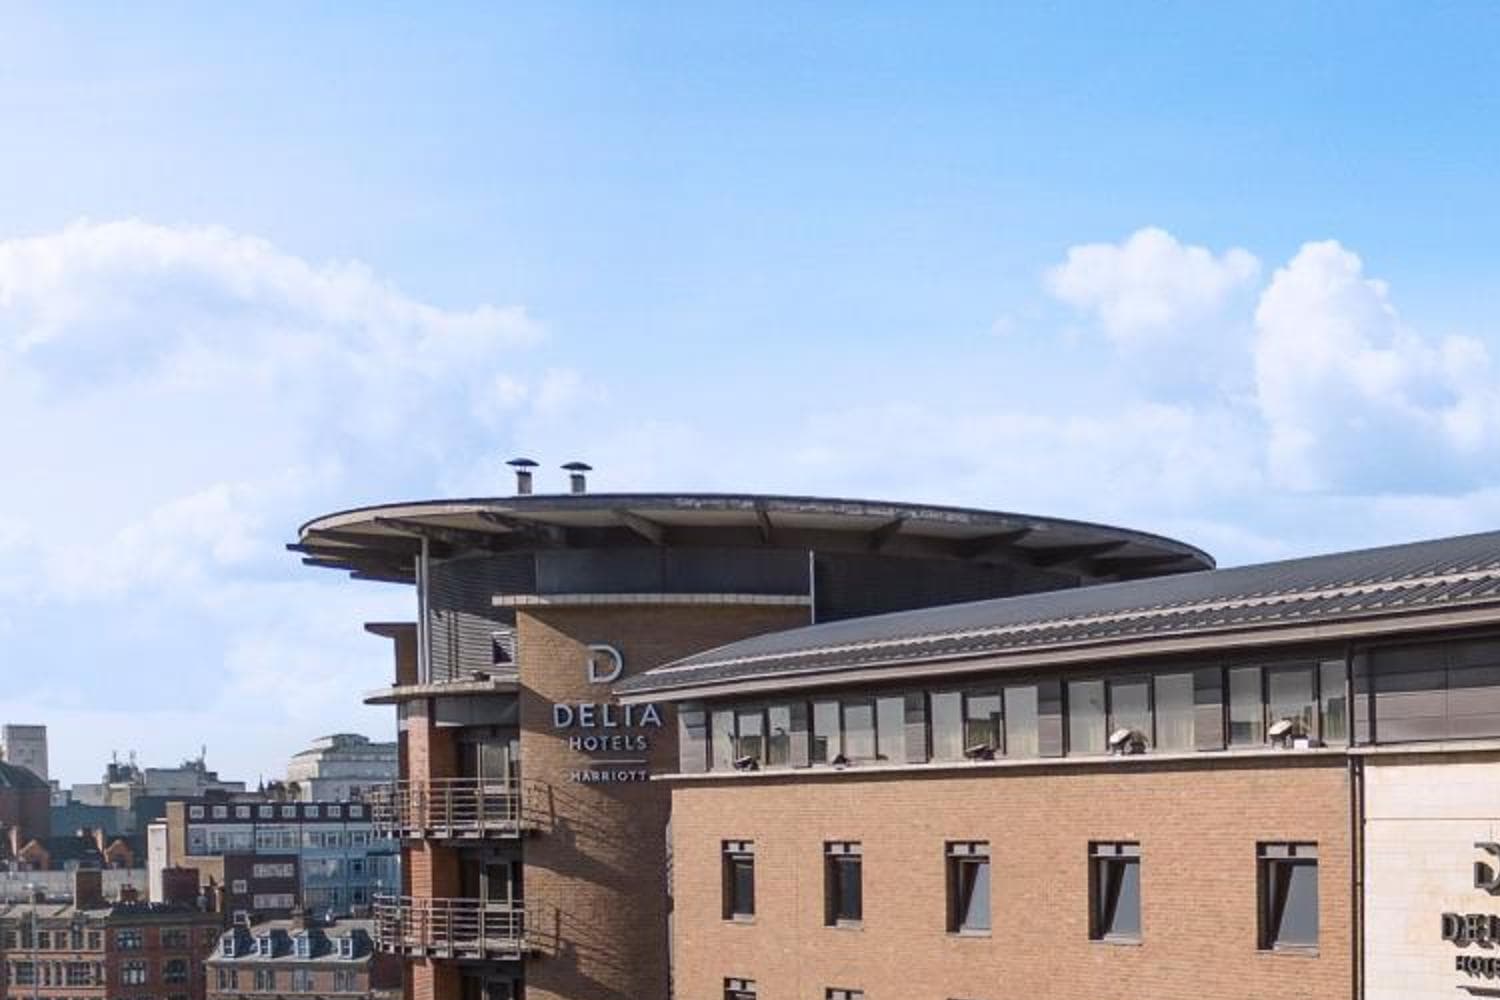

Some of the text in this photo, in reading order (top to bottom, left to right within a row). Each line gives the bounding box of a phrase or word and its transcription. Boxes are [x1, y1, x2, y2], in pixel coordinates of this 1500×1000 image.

[553, 703, 661, 728] DELTA
[569, 736, 647, 750] HOTELS
[568, 770, 647, 781] MARRIOTT
